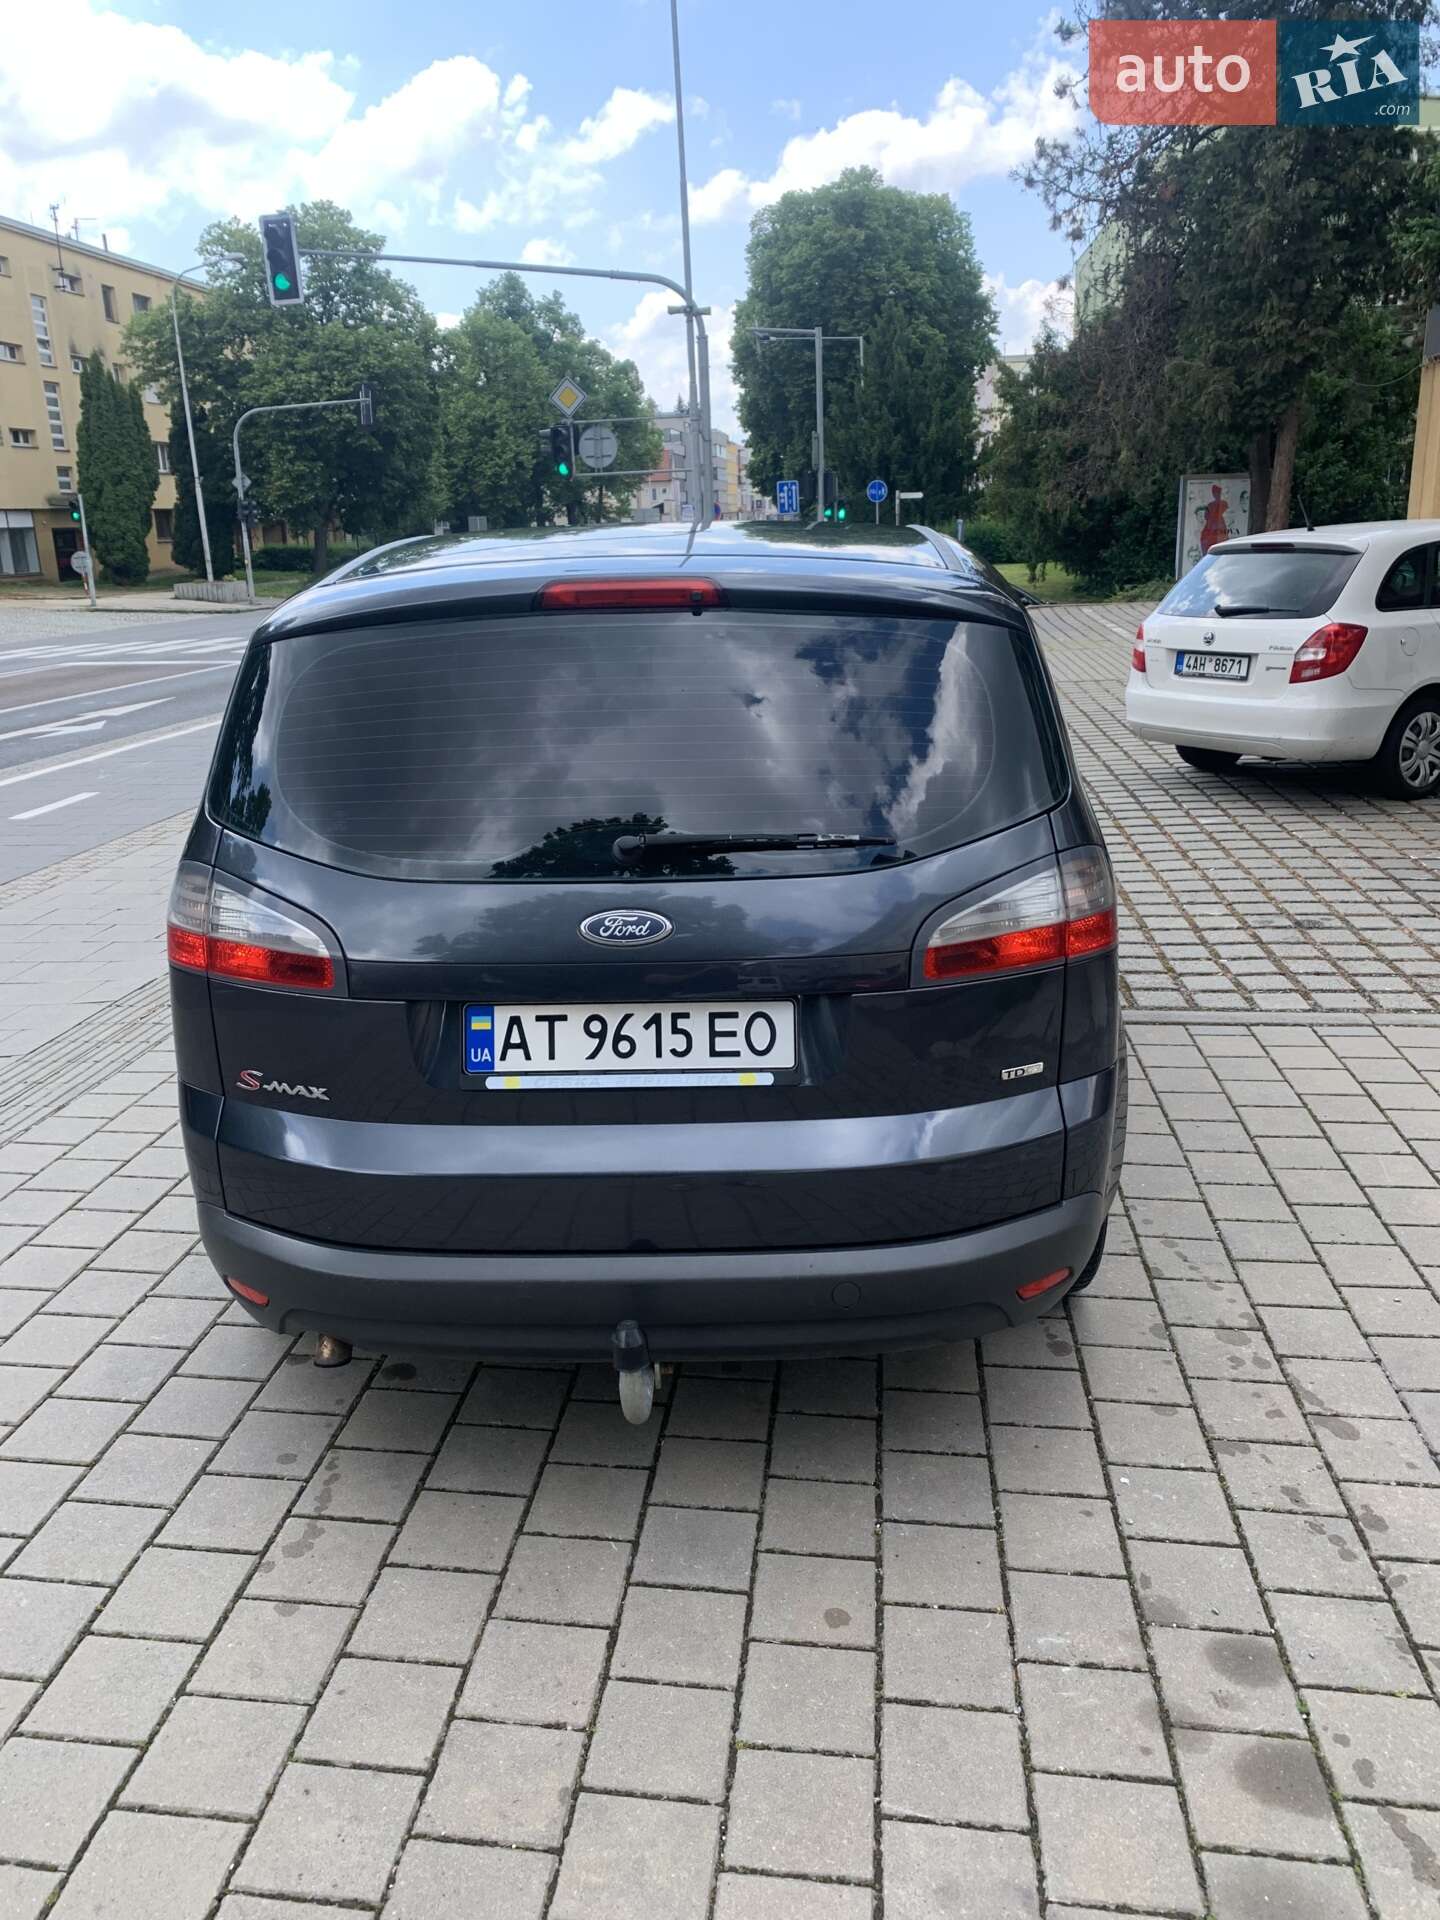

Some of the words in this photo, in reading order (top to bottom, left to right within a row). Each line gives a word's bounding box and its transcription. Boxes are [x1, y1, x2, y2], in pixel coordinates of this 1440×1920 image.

[599, 916, 651, 937] Ford
[499, 1014, 568, 1061] AT
[583, 1012, 693, 1060] 9615
[708, 1010, 777, 1057] EO
[471, 1048, 491, 1062] UA
